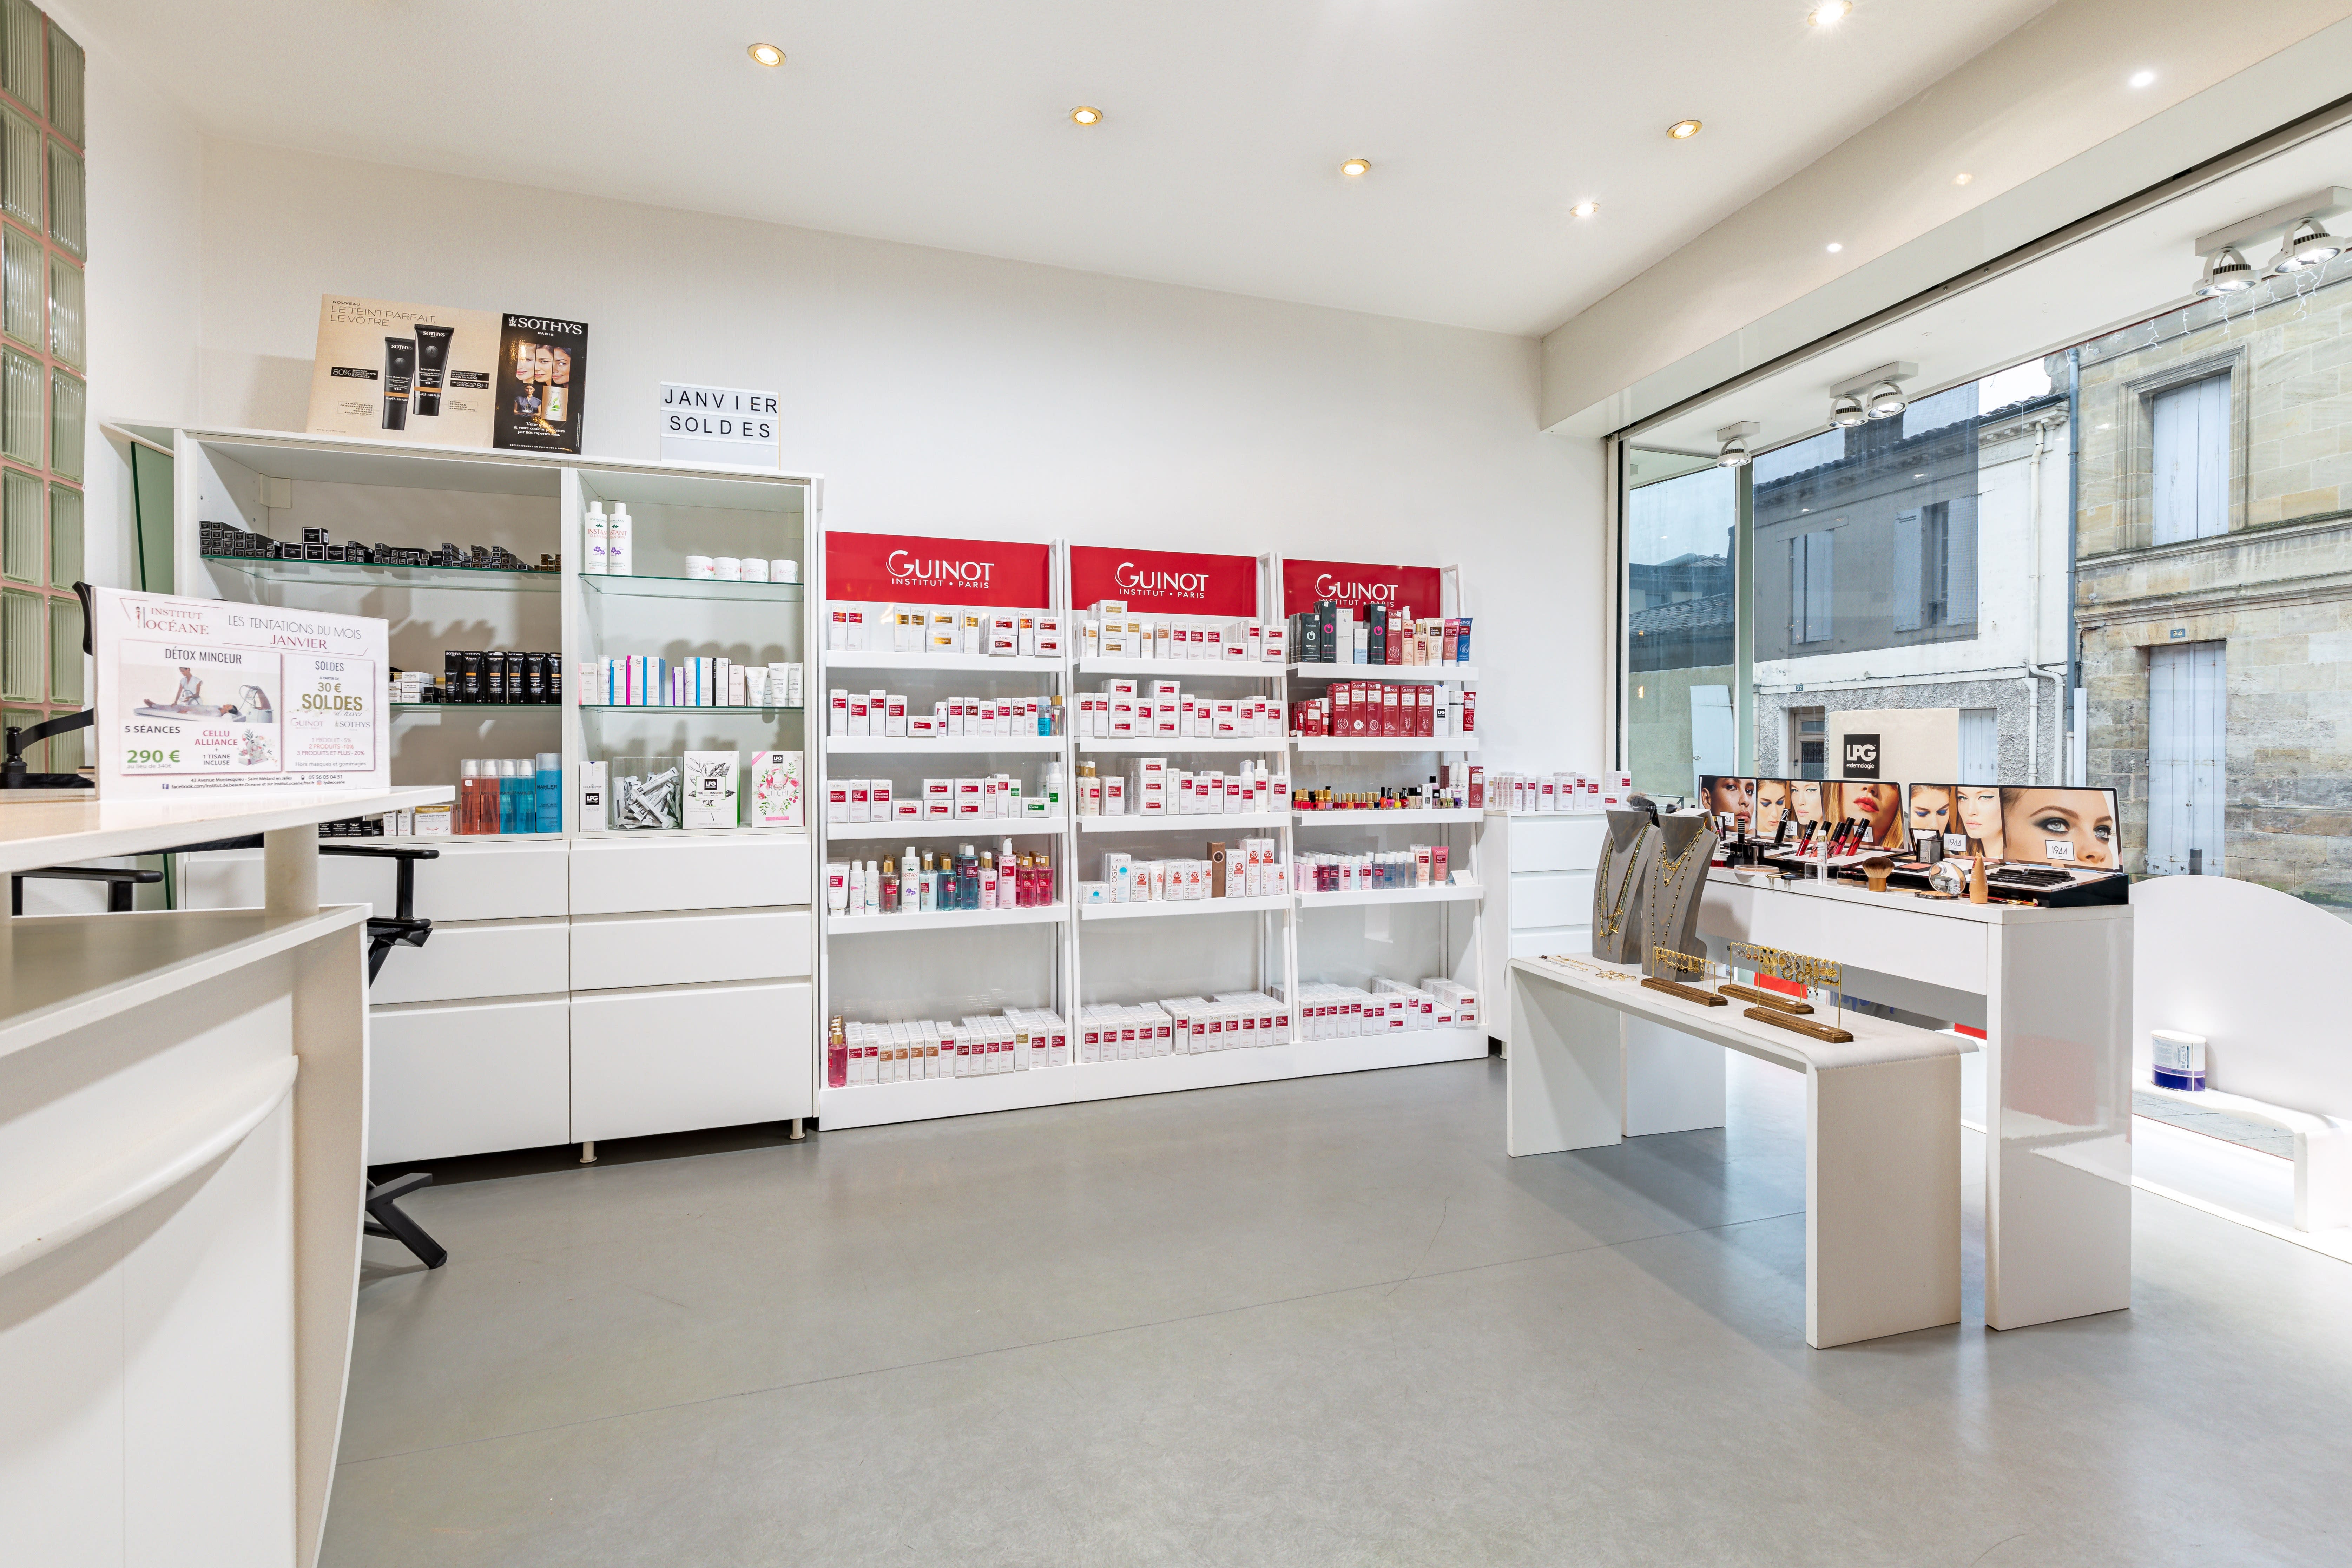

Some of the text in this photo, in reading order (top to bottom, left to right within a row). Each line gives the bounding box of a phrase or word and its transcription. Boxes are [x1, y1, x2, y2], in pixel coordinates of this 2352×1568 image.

[349, 307, 384, 317] TEINT
[386, 311, 436, 324] PARFAIT,
[518, 318, 582, 335] SOTHYS
[665, 389, 777, 413] JANVIER
[670, 416, 770, 438] SOLDES
[892, 578, 943, 586] INSTITUT
[1120, 588, 1164, 597] INSTITUT
[151, 608, 203, 619] INSTITUT
[146, 620, 209, 635] OCÉANE
[228, 615, 361, 639] LES TENTATIONS DU MOIS
[270, 635, 327, 650] JANVIER
[165, 646, 242, 664] DÉTOX MINCEUR
[315, 661, 344, 672] SOLDES
[318, 682, 341, 692] 30 €
[302, 693, 363, 711] SOLDES
[134, 724, 180, 733] SÉANCES
[127, 750, 180, 763] 290 €
[1846, 744, 1876, 761] LPG
